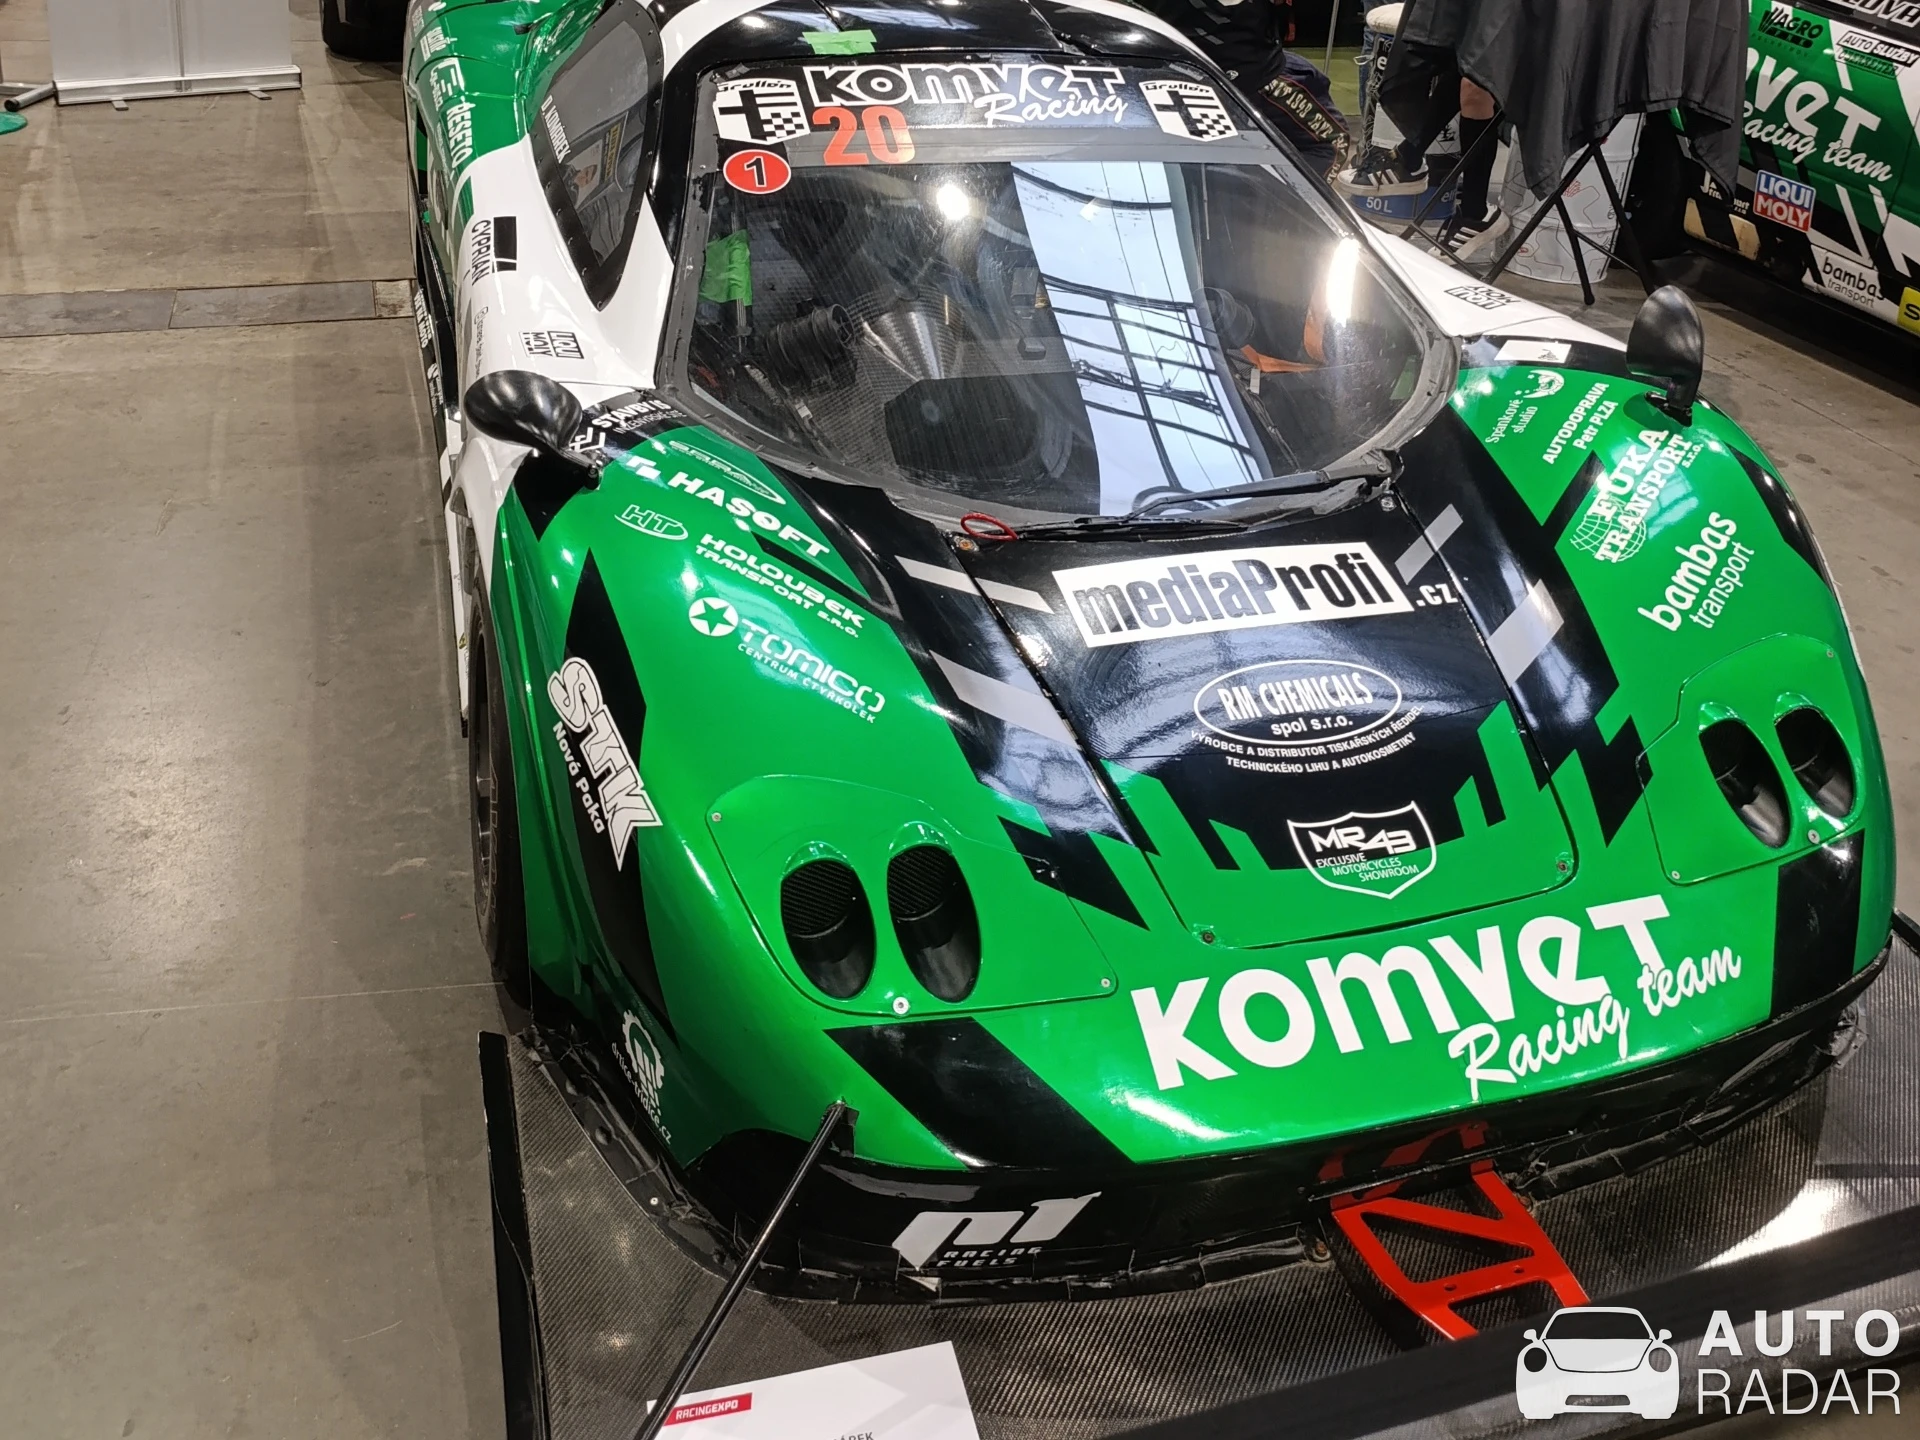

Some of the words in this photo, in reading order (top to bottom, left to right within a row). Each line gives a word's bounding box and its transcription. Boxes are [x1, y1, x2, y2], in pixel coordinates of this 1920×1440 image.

[1843, 35, 1873, 50] AUTO
[975, 90, 1128, 129] Racing
[812, 105, 916, 166] 20
[744, 156, 767, 187] 1
[1823, 138, 1893, 182] team
[1366, 196, 1382, 211] 50
[1383, 199, 1393, 213] L
[1759, 174, 1812, 209] LIQUI
[1756, 194, 1810, 229] MOLY
[471, 219, 492, 287] CYPRIAN
[1827, 277, 1877, 308] transport
[592, 401, 656, 428] STAVBY
[1485, 398, 1524, 444] Spánkové
[1511, 405, 1539, 434] studio
[1542, 381, 1610, 465] AUTODOPRAVA
[1572, 424, 1600, 450] Petr
[1589, 399, 1619, 427] PLZA
[1681, 442, 1705, 469] s.r.o.
[668, 471, 830, 557] HASOFT
[1594, 433, 1693, 564] TRANSPORT
[696, 544, 814, 610] TRANSPORT
[700, 534, 865, 628] HOLOUBEK
[1637, 511, 1737, 632] bambas
[1688, 540, 1755, 629] transport
[738, 643, 799, 680] CENTRUM
[1217, 684, 1264, 721] RM
[1258, 671, 1374, 716] CHEMICALS
[1190, 729, 1244, 755] VÝROBCE
[1246, 746, 1256, 756] A
[1257, 744, 1326, 758] DISTRIBUTOR
[1326, 727, 1393, 754] TISKAŘSKÝCH
[1270, 716, 1308, 738] spol
[1311, 714, 1354, 731] s.r.o.
[1226, 756, 1304, 773] TECHNICKÉHO
[1305, 760, 1330, 773] LIHU
[1332, 759, 1341, 770] A
[1341, 731, 1417, 768] AUTOKOSMETIKY
[552, 720, 582, 777] Nová
[575, 776, 606, 835] Paka
[1308, 825, 1418, 856] MR43
[1315, 851, 1368, 869] EXCLUSIVE
[1331, 856, 1403, 877] MOTORCYCLES
[1358, 864, 1420, 883] SHOWROOM
[1448, 993, 1631, 1101] Racing
[1637, 946, 1742, 1017] team
[936, 1257, 1018, 1267] FUELS
[944, 1247, 1043, 1258] RACING
[676, 1399, 739, 1421] RACINGEXPO
